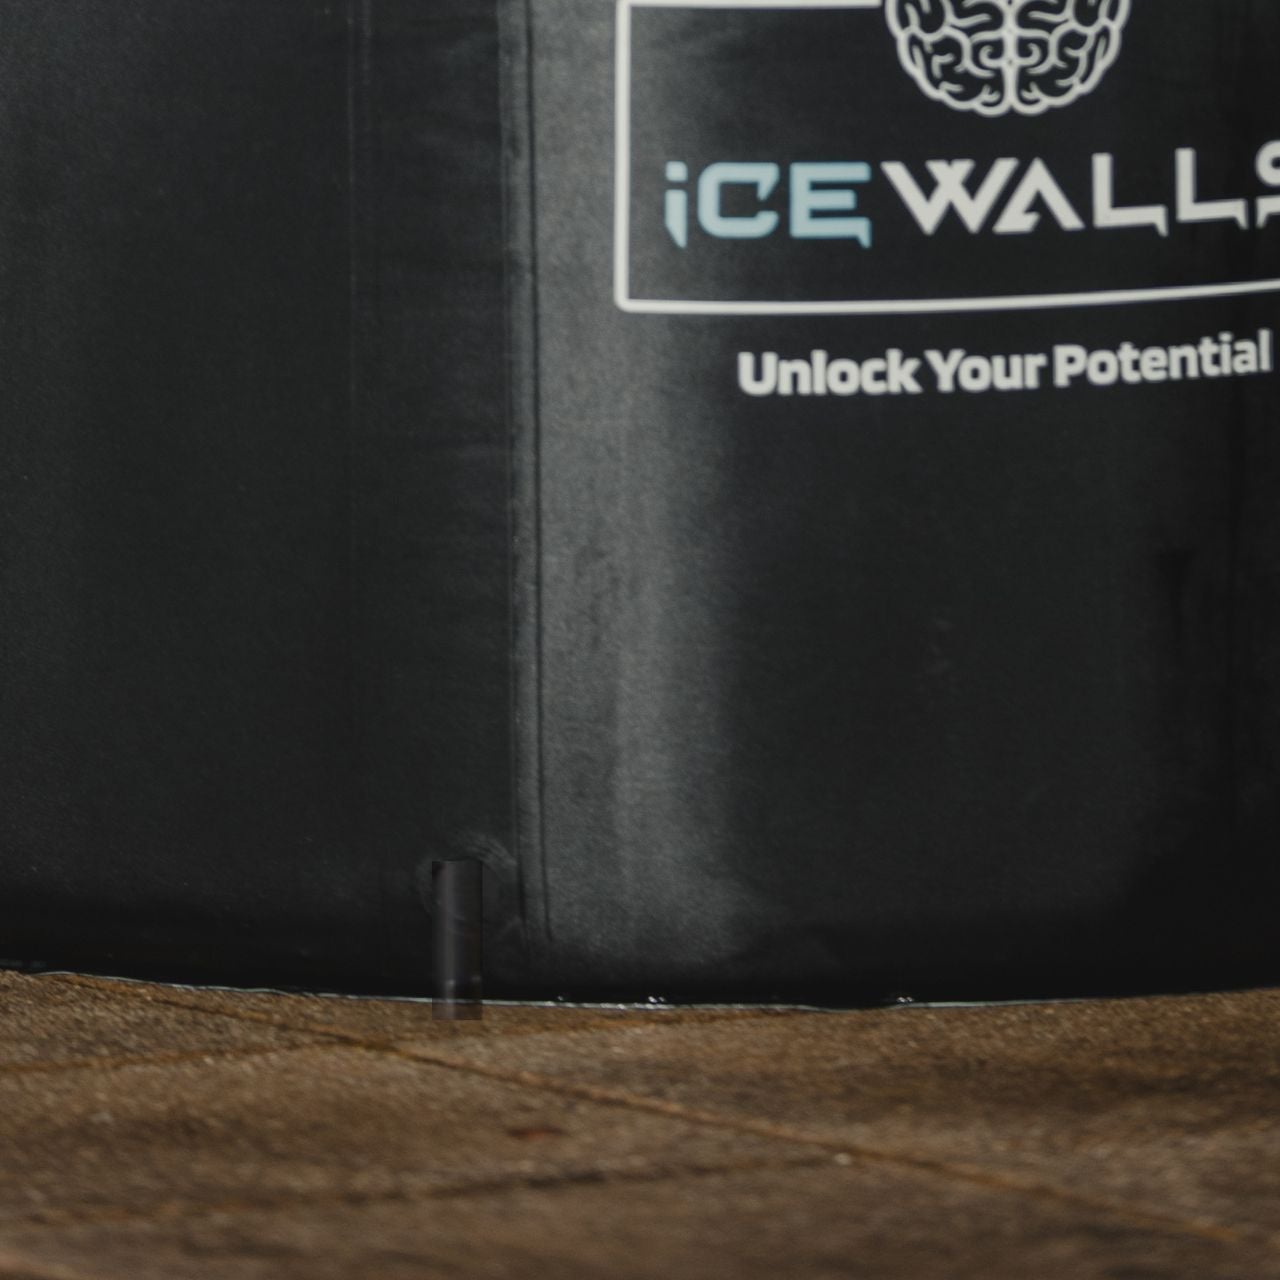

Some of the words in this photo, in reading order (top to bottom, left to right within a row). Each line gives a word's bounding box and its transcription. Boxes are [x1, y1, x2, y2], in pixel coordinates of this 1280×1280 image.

[737, 348, 922, 396] Unlock
[925, 348, 1047, 393] Your
[1053, 329, 1271, 388] Potential
